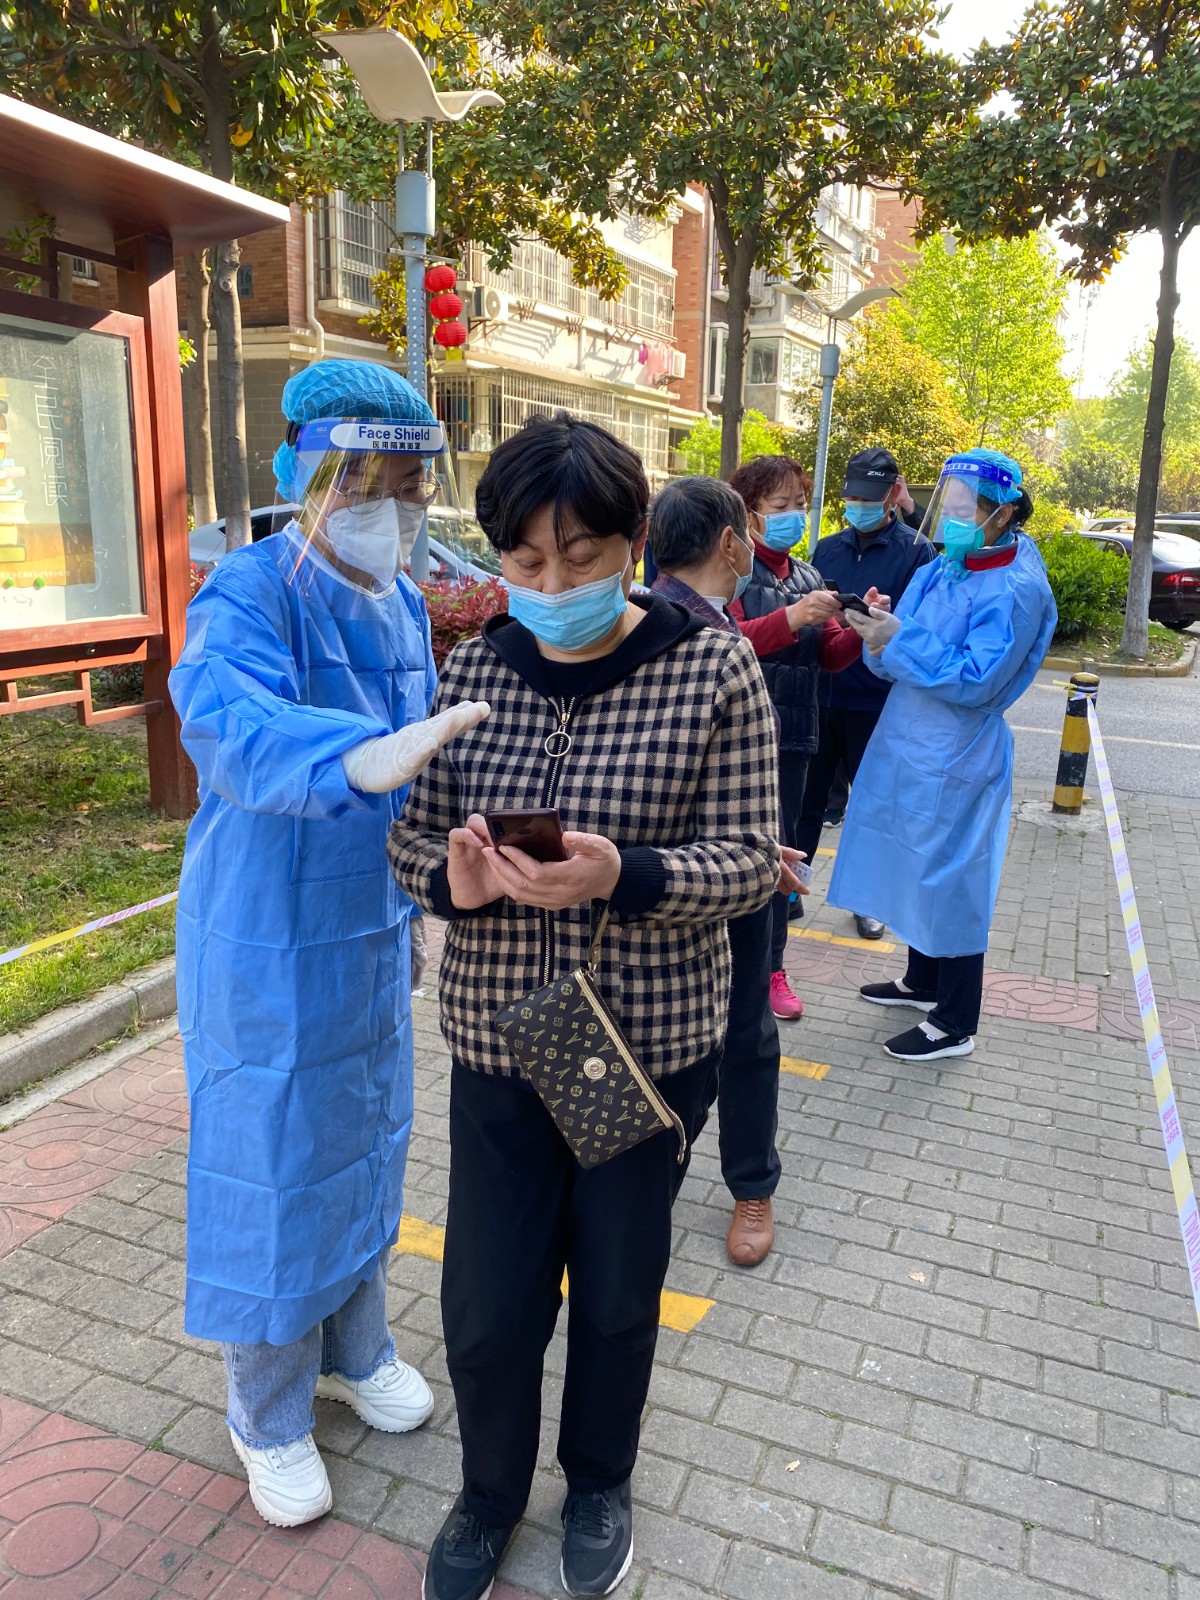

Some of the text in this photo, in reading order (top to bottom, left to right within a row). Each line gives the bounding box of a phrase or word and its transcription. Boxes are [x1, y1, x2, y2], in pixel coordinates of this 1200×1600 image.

[31, 354, 70, 507] 全民阅读
[358, 425, 431, 441] Face Shield
[372, 440, 421, 450] 医用隔离面罩
